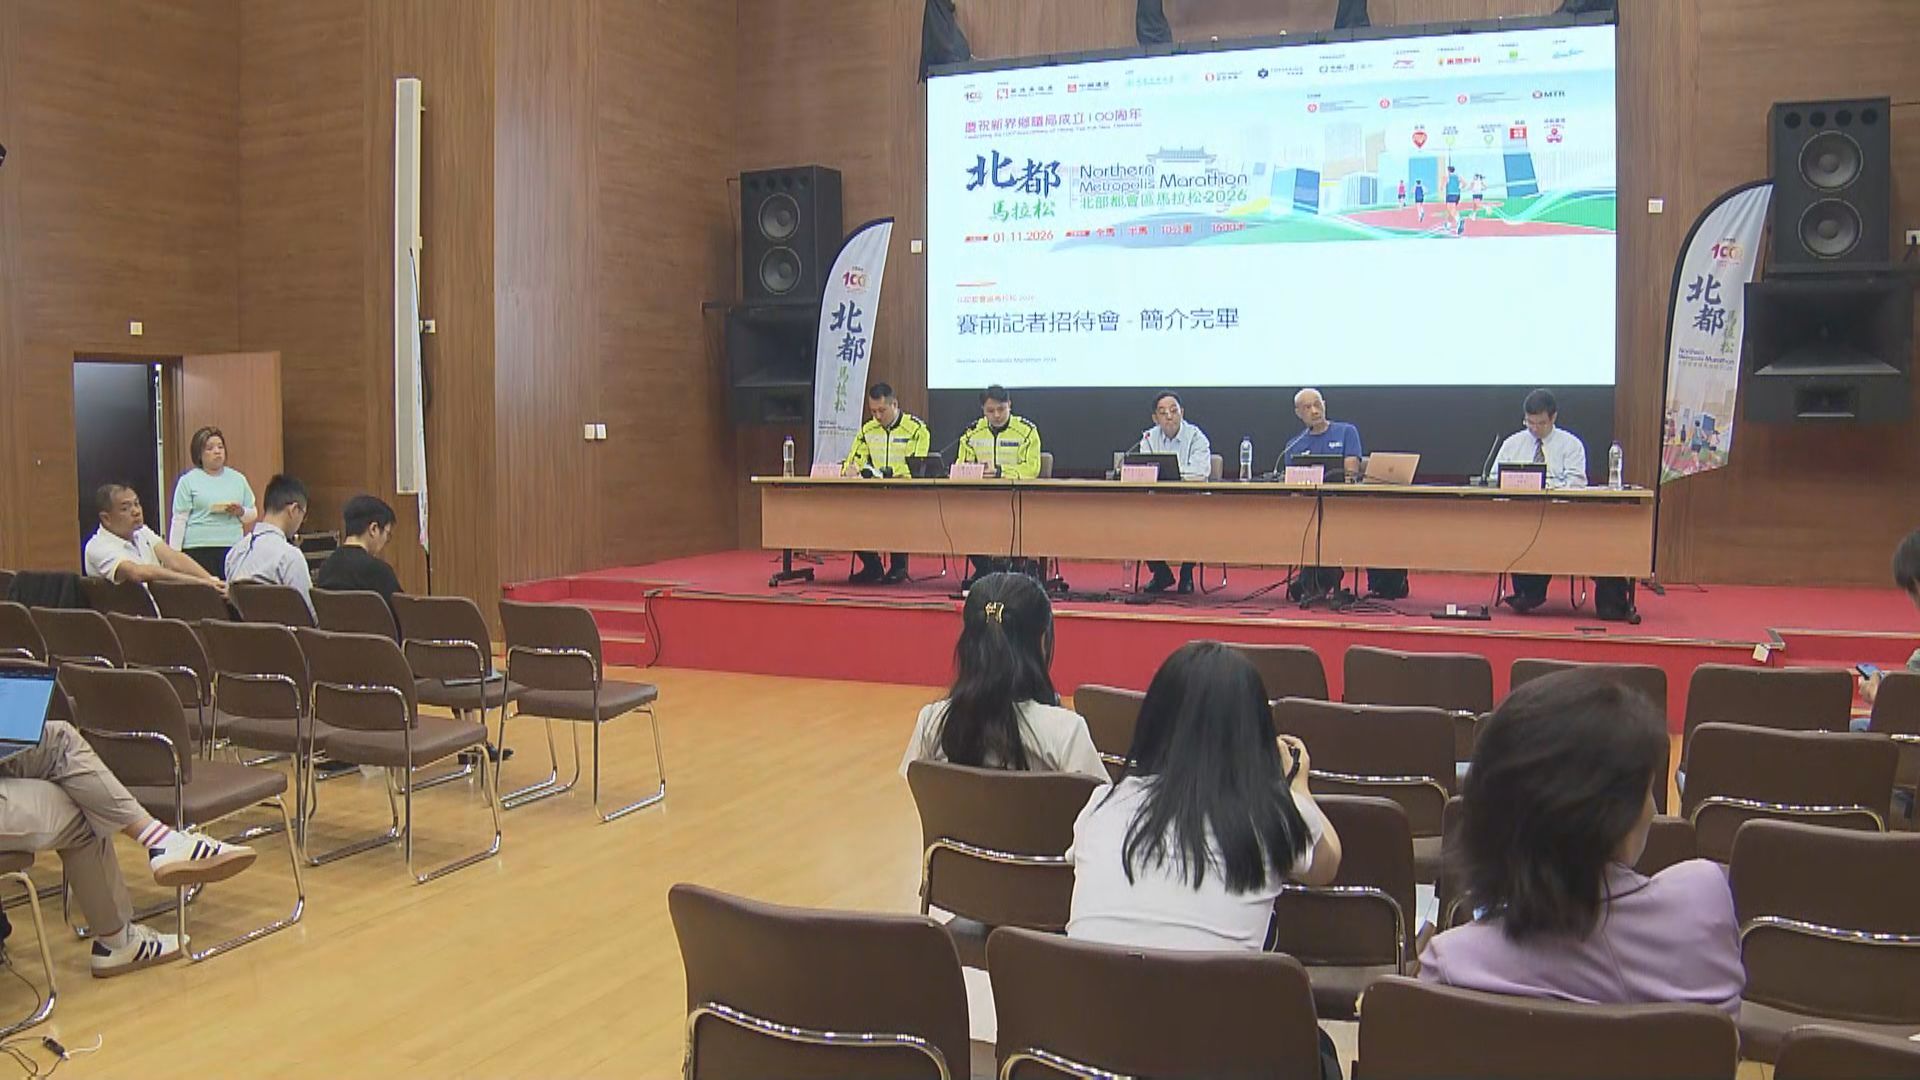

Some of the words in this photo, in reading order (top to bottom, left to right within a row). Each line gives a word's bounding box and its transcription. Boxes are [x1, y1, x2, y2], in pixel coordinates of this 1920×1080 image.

[966, 150, 1061, 199] 北都
[1080, 162, 1155, 179] Northern
[1080, 178, 1155, 194] Metropolis
[1159, 171, 1248, 188] Marathon
[989, 199, 1056, 222] 馬拉松
[992, 230, 1054, 243] 01.11.2026
[1686, 273, 1726, 336] 北都
[829, 299, 867, 366] 北都
[957, 309, 1120, 335] 賽前記者招待會
[1140, 307, 1239, 332] 簡介完畢
